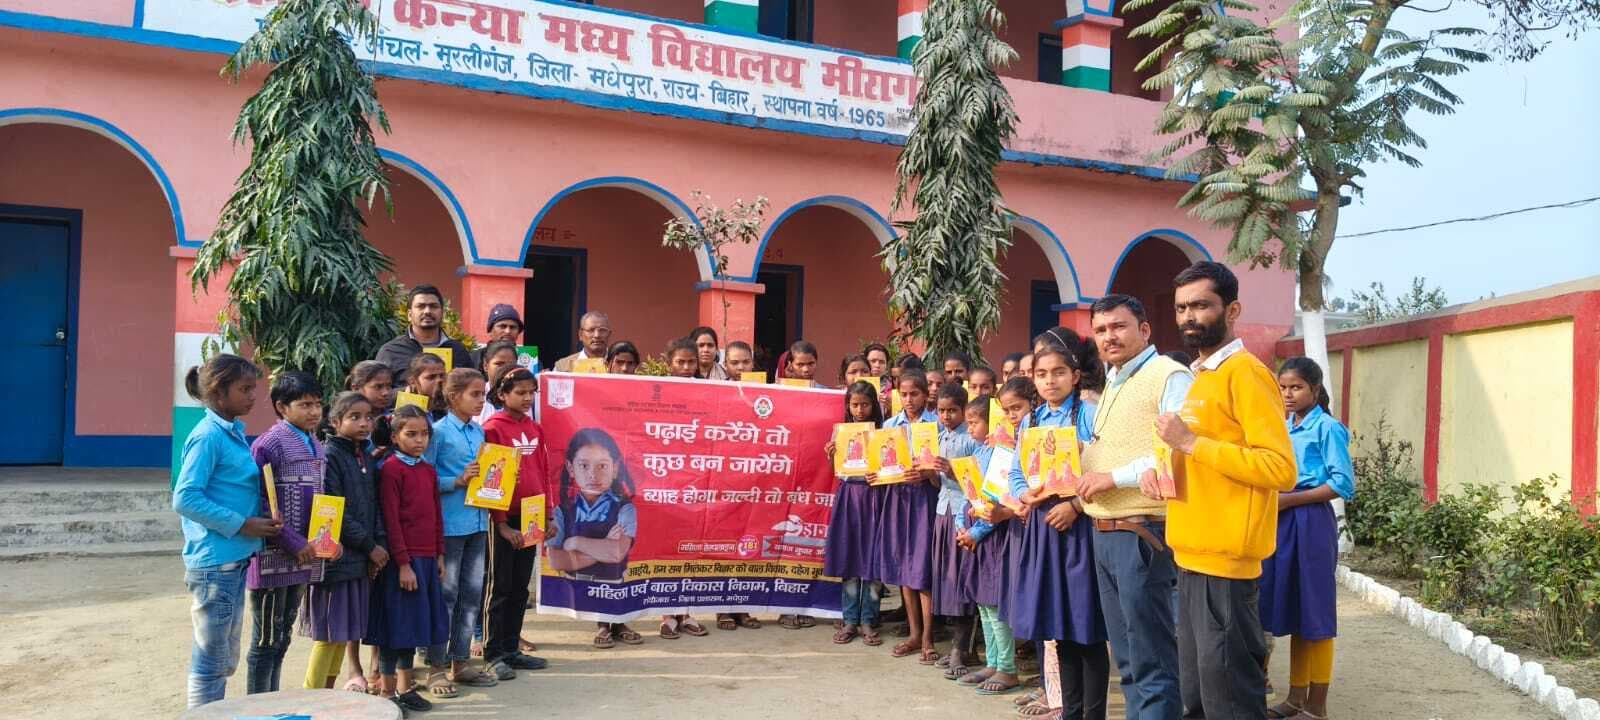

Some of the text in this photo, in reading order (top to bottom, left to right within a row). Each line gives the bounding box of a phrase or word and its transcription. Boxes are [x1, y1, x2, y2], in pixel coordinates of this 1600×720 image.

[393, 0, 922, 106] कन्या मध्य विद्यालय मीराग
[762, 94, 812, 118] स्थापना
[848, 107, 885, 128] 1965
[643, 419, 791, 446] पढ़ाई करेंगे तो
[643, 451, 794, 476] कुछ बन जायेंगे
[643, 487, 679, 504] ब्याह
[682, 485, 717, 504] होगा
[721, 486, 762, 503] जल्दी
[765, 487, 784, 504] तो
[814, 492, 835, 507] जा
[587, 583, 627, 599] महिला
[630, 579, 648, 598] एवं
[650, 580, 677, 594] बाल
[681, 577, 725, 593] विकास
[774, 578, 810, 594] बिहार
